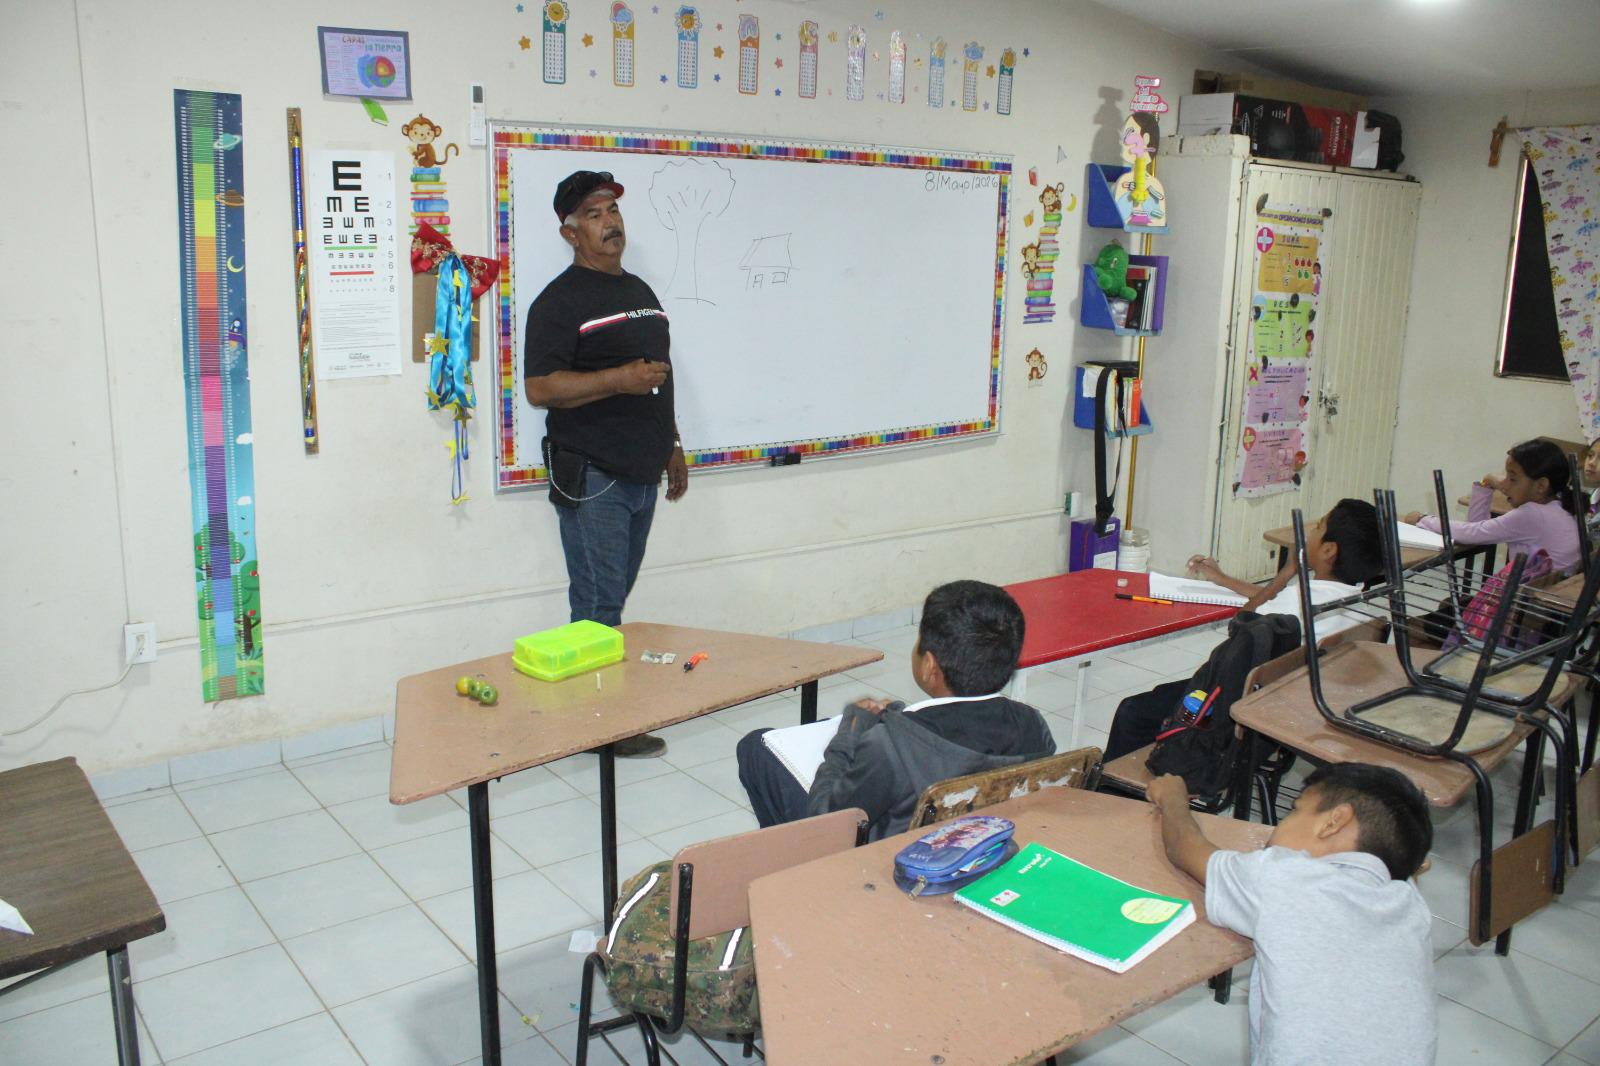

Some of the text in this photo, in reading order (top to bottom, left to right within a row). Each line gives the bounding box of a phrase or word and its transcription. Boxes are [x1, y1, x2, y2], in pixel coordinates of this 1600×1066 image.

[332, 161, 362, 191] E
[354, 196, 370, 212] E
[386, 201, 392, 209] 2
[387, 218, 392, 226] 3
[323, 234, 333, 244] E
[354, 234, 363, 243] E
